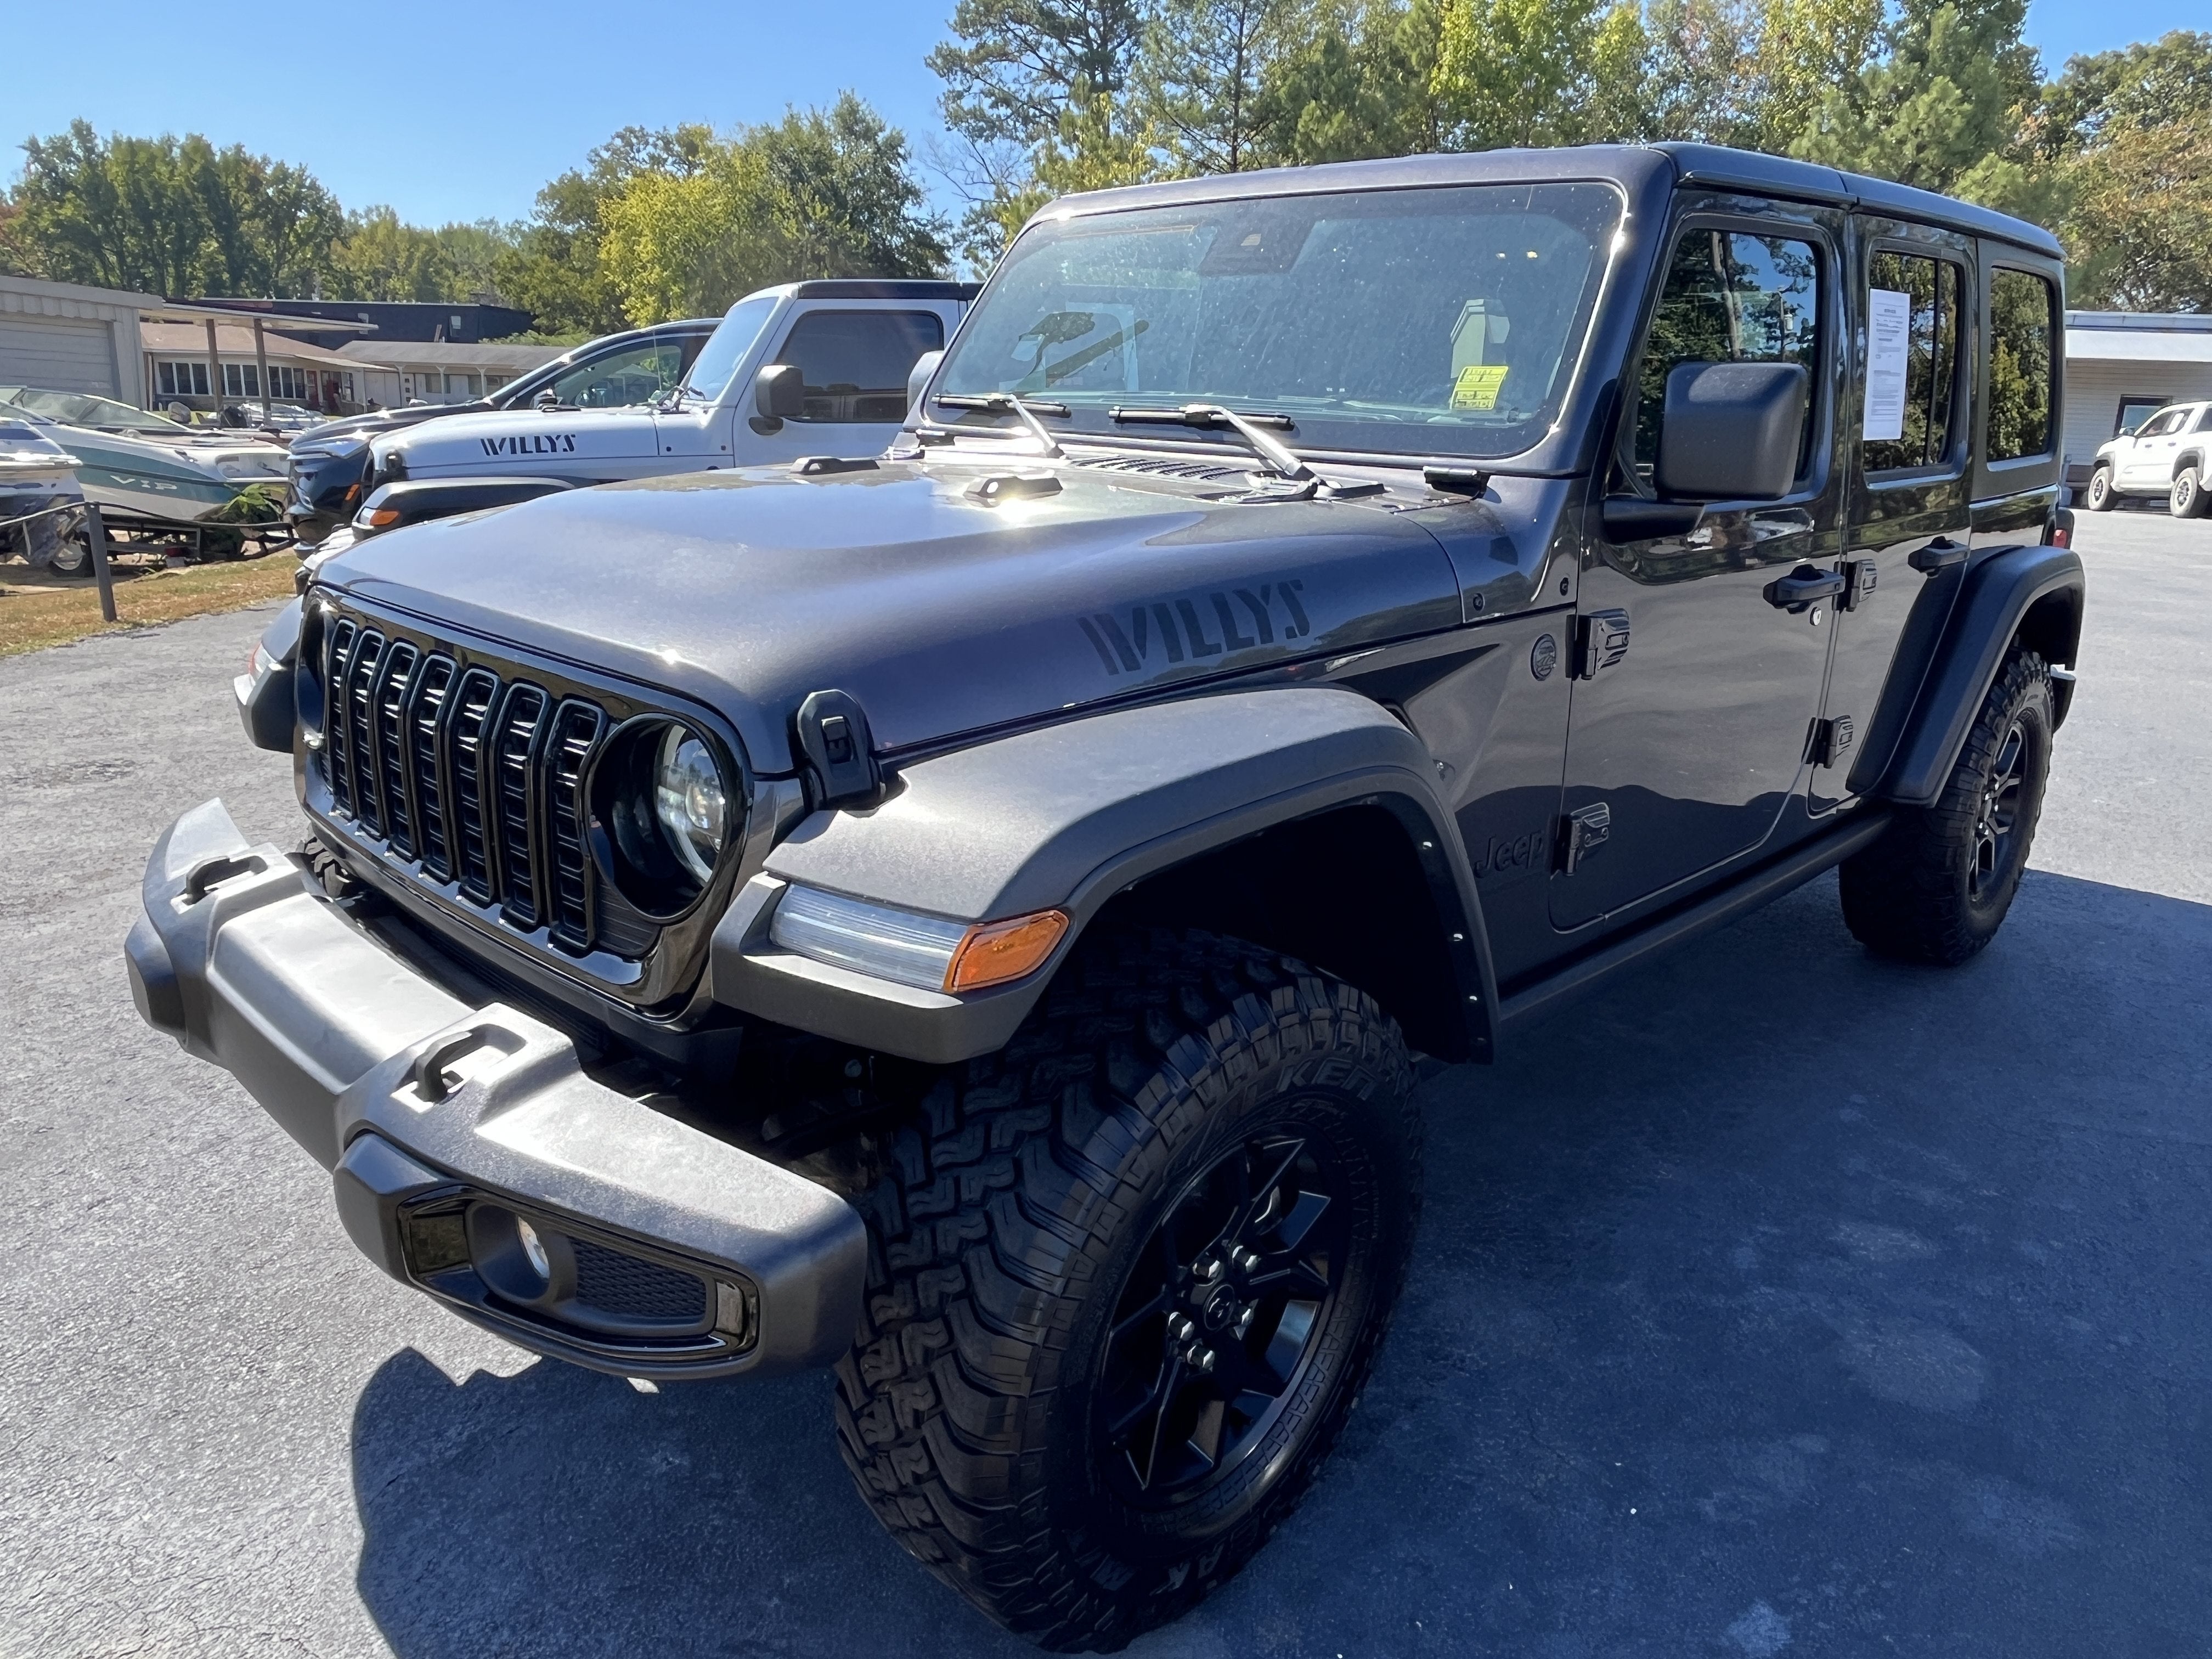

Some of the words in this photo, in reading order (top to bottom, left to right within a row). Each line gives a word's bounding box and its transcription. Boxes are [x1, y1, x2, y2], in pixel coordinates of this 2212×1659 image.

[481, 434, 575, 456] WILLYS
[110, 475, 177, 490] VIP
[1076, 579, 1310, 676] WILLYS
[1474, 830, 1544, 879] Jeep
